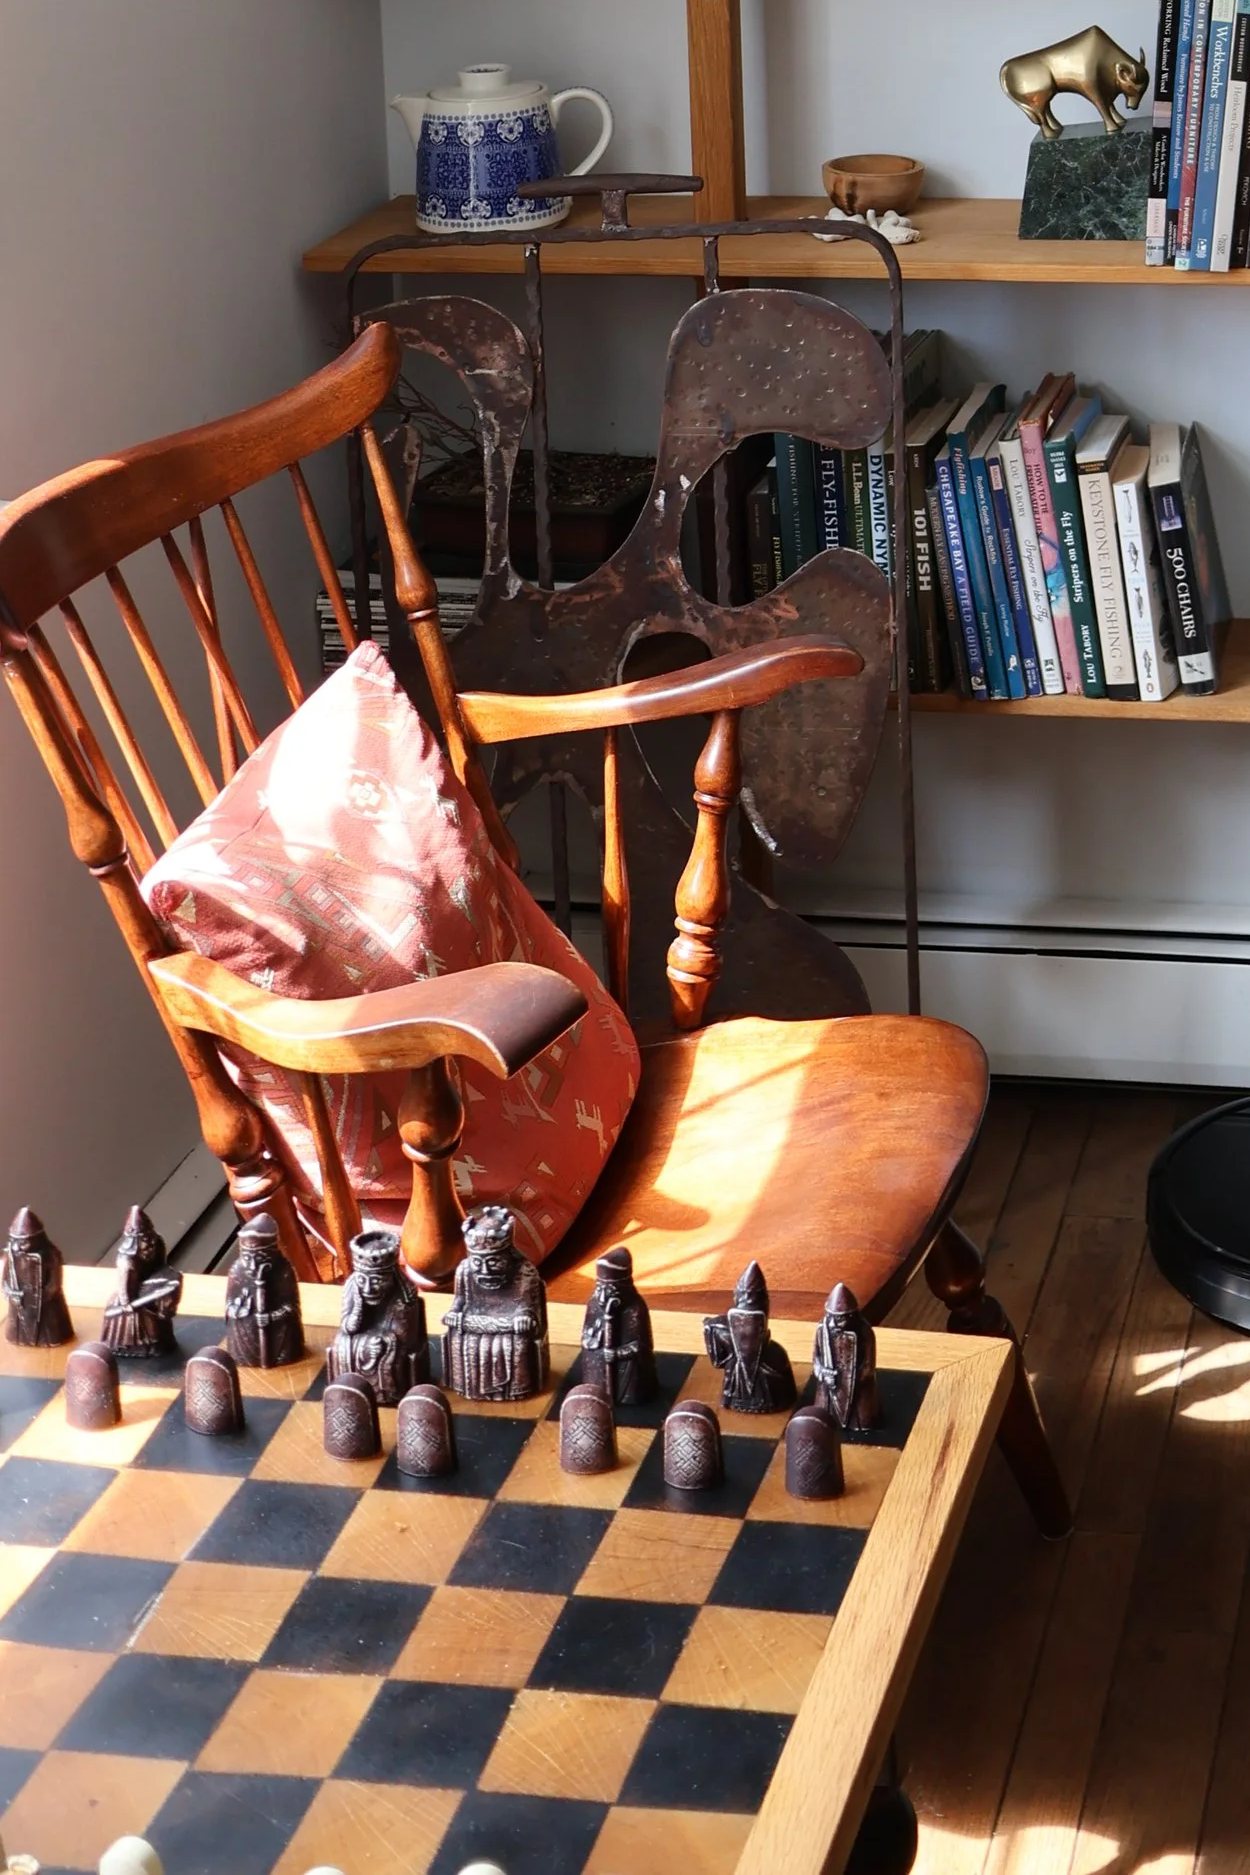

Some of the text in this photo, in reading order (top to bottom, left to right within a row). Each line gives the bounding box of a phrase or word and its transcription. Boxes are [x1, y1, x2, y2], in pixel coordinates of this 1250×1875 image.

[1195, 19, 1205, 29] IN
[1159, 72, 1168, 93] Wood
[1160, 37, 1171, 73] Reclaimed
[1190, 33, 1204, 110] CONTEMPORARY
[1210, 25, 1229, 99] Workbenches
[1186, 112, 1198, 165] FURNITURE
[938, 465, 960, 547] CHESAPEAKE
[1088, 479, 1110, 562] KEYSTONE
[914, 507, 932, 591] 101 FISH
[952, 550, 965, 574] BAY
[958, 587, 971, 623] FIELD
[1060, 511, 1097, 684] LOU TABORY Stripers on the Fly
[1100, 566, 1115, 592] FLY
[1165, 547, 1197, 639] 500 CHAIRS
[965, 626, 980, 664] GUIDE
[1104, 597, 1124, 659] FISHING
